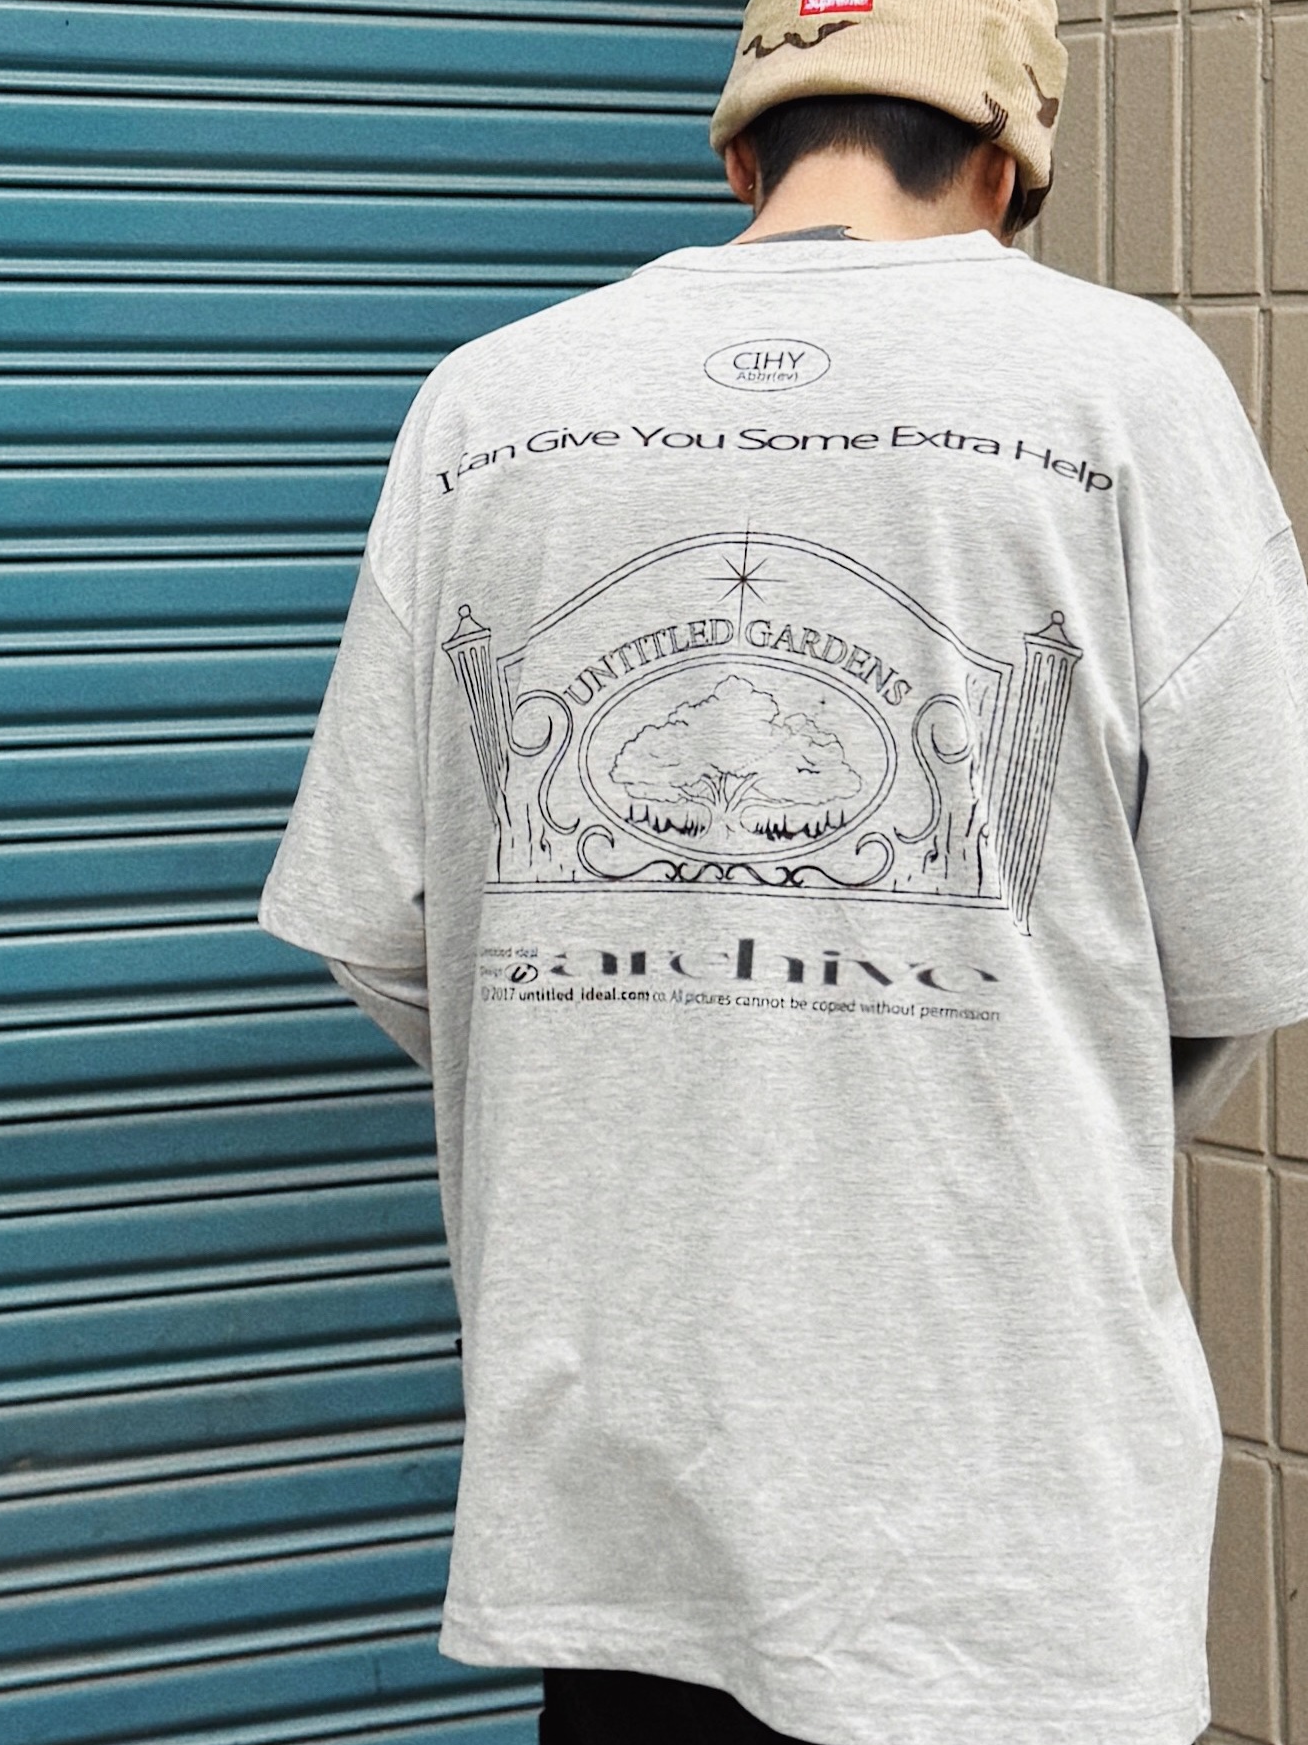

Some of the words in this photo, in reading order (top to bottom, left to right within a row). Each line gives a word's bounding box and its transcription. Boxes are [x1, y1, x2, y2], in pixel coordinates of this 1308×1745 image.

[733, 351, 806, 370] CIHY
[436, 471, 454, 495] I
[526, 427, 621, 453] Give
[631, 426, 725, 450] You
[737, 428, 880, 451] Some
[891, 425, 1001, 456] Extra
[1014, 440, 1113, 493] Help
[562, 618, 735, 707] UNTITLED
[744, 618, 913, 707] GARDENS
[735, 995, 784, 1009] cannot
[790, 998, 808, 1010] be
[859, 1000, 914, 1018] without
